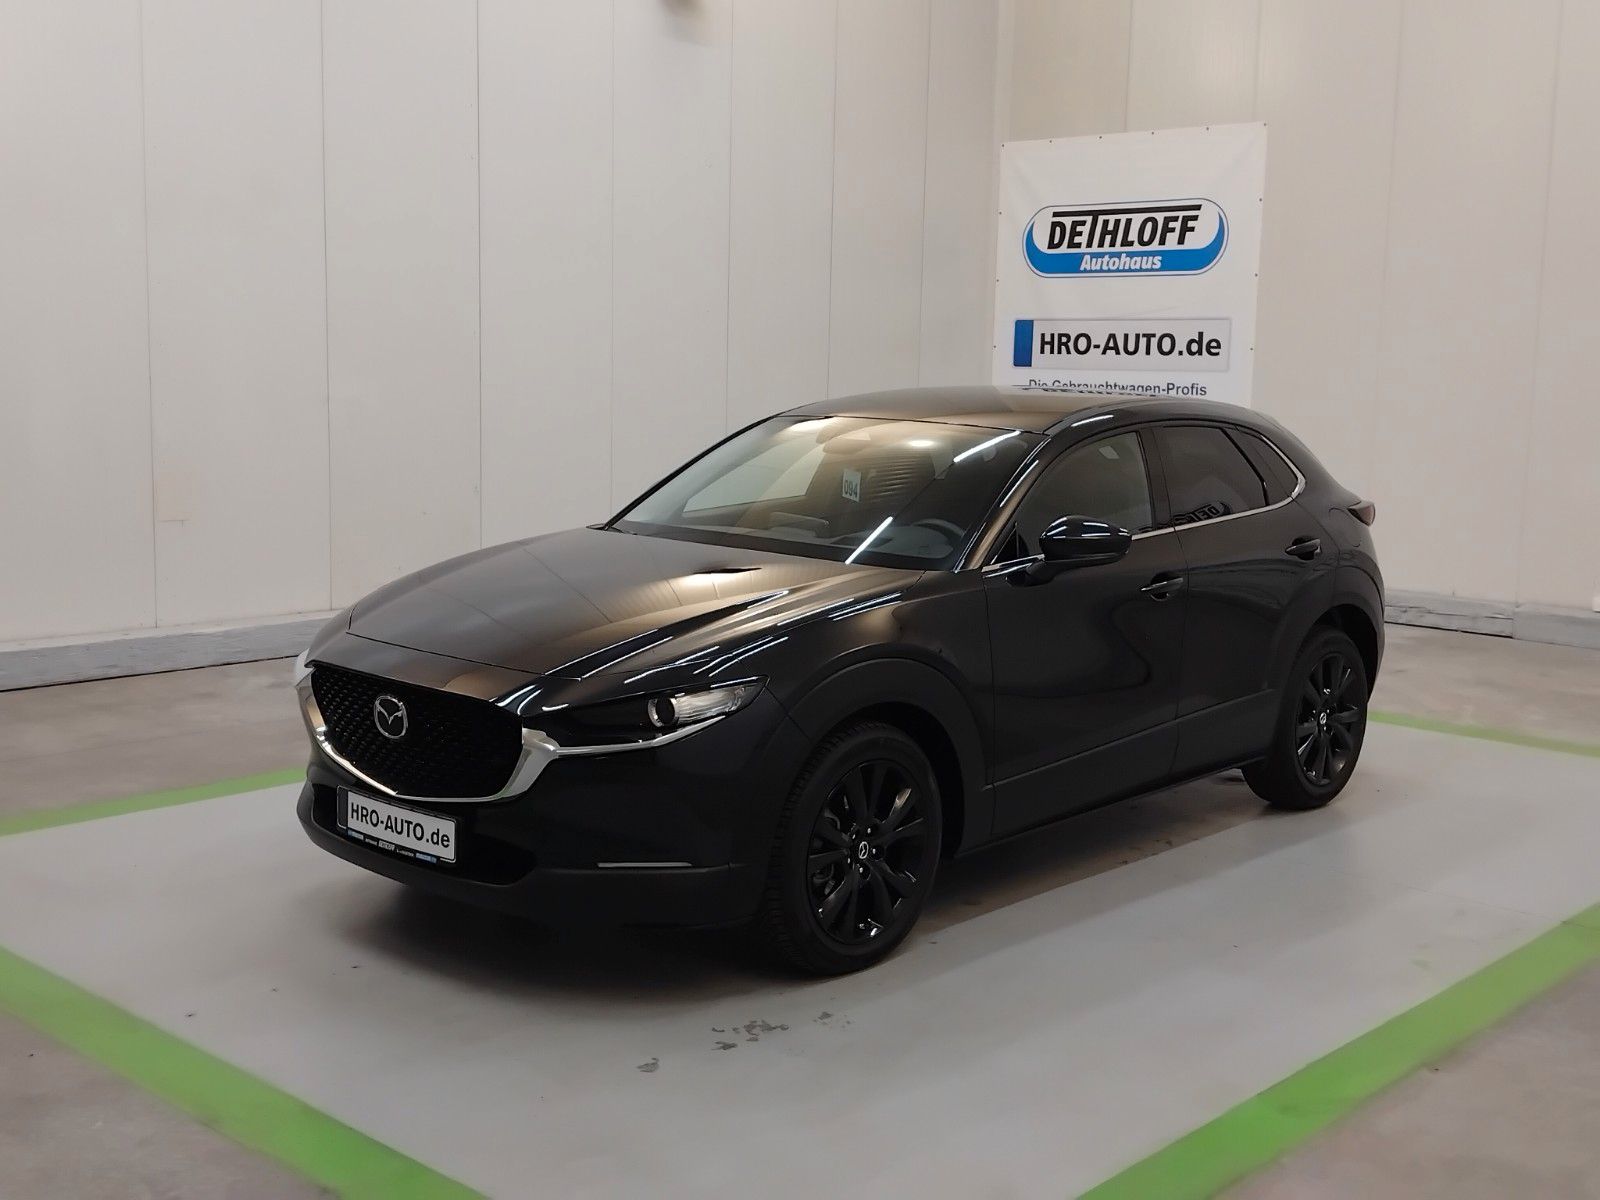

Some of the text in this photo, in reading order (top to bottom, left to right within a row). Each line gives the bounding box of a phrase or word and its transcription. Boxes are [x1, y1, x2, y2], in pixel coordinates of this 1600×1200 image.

[1047, 204, 1202, 250] DETHLOFF
[1080, 254, 1162, 271] Autohaus
[1039, 332, 1222, 356] HRO-AUTO.de
[844, 479, 858, 498] 094
[350, 802, 450, 848] HRO-AUTO.de
